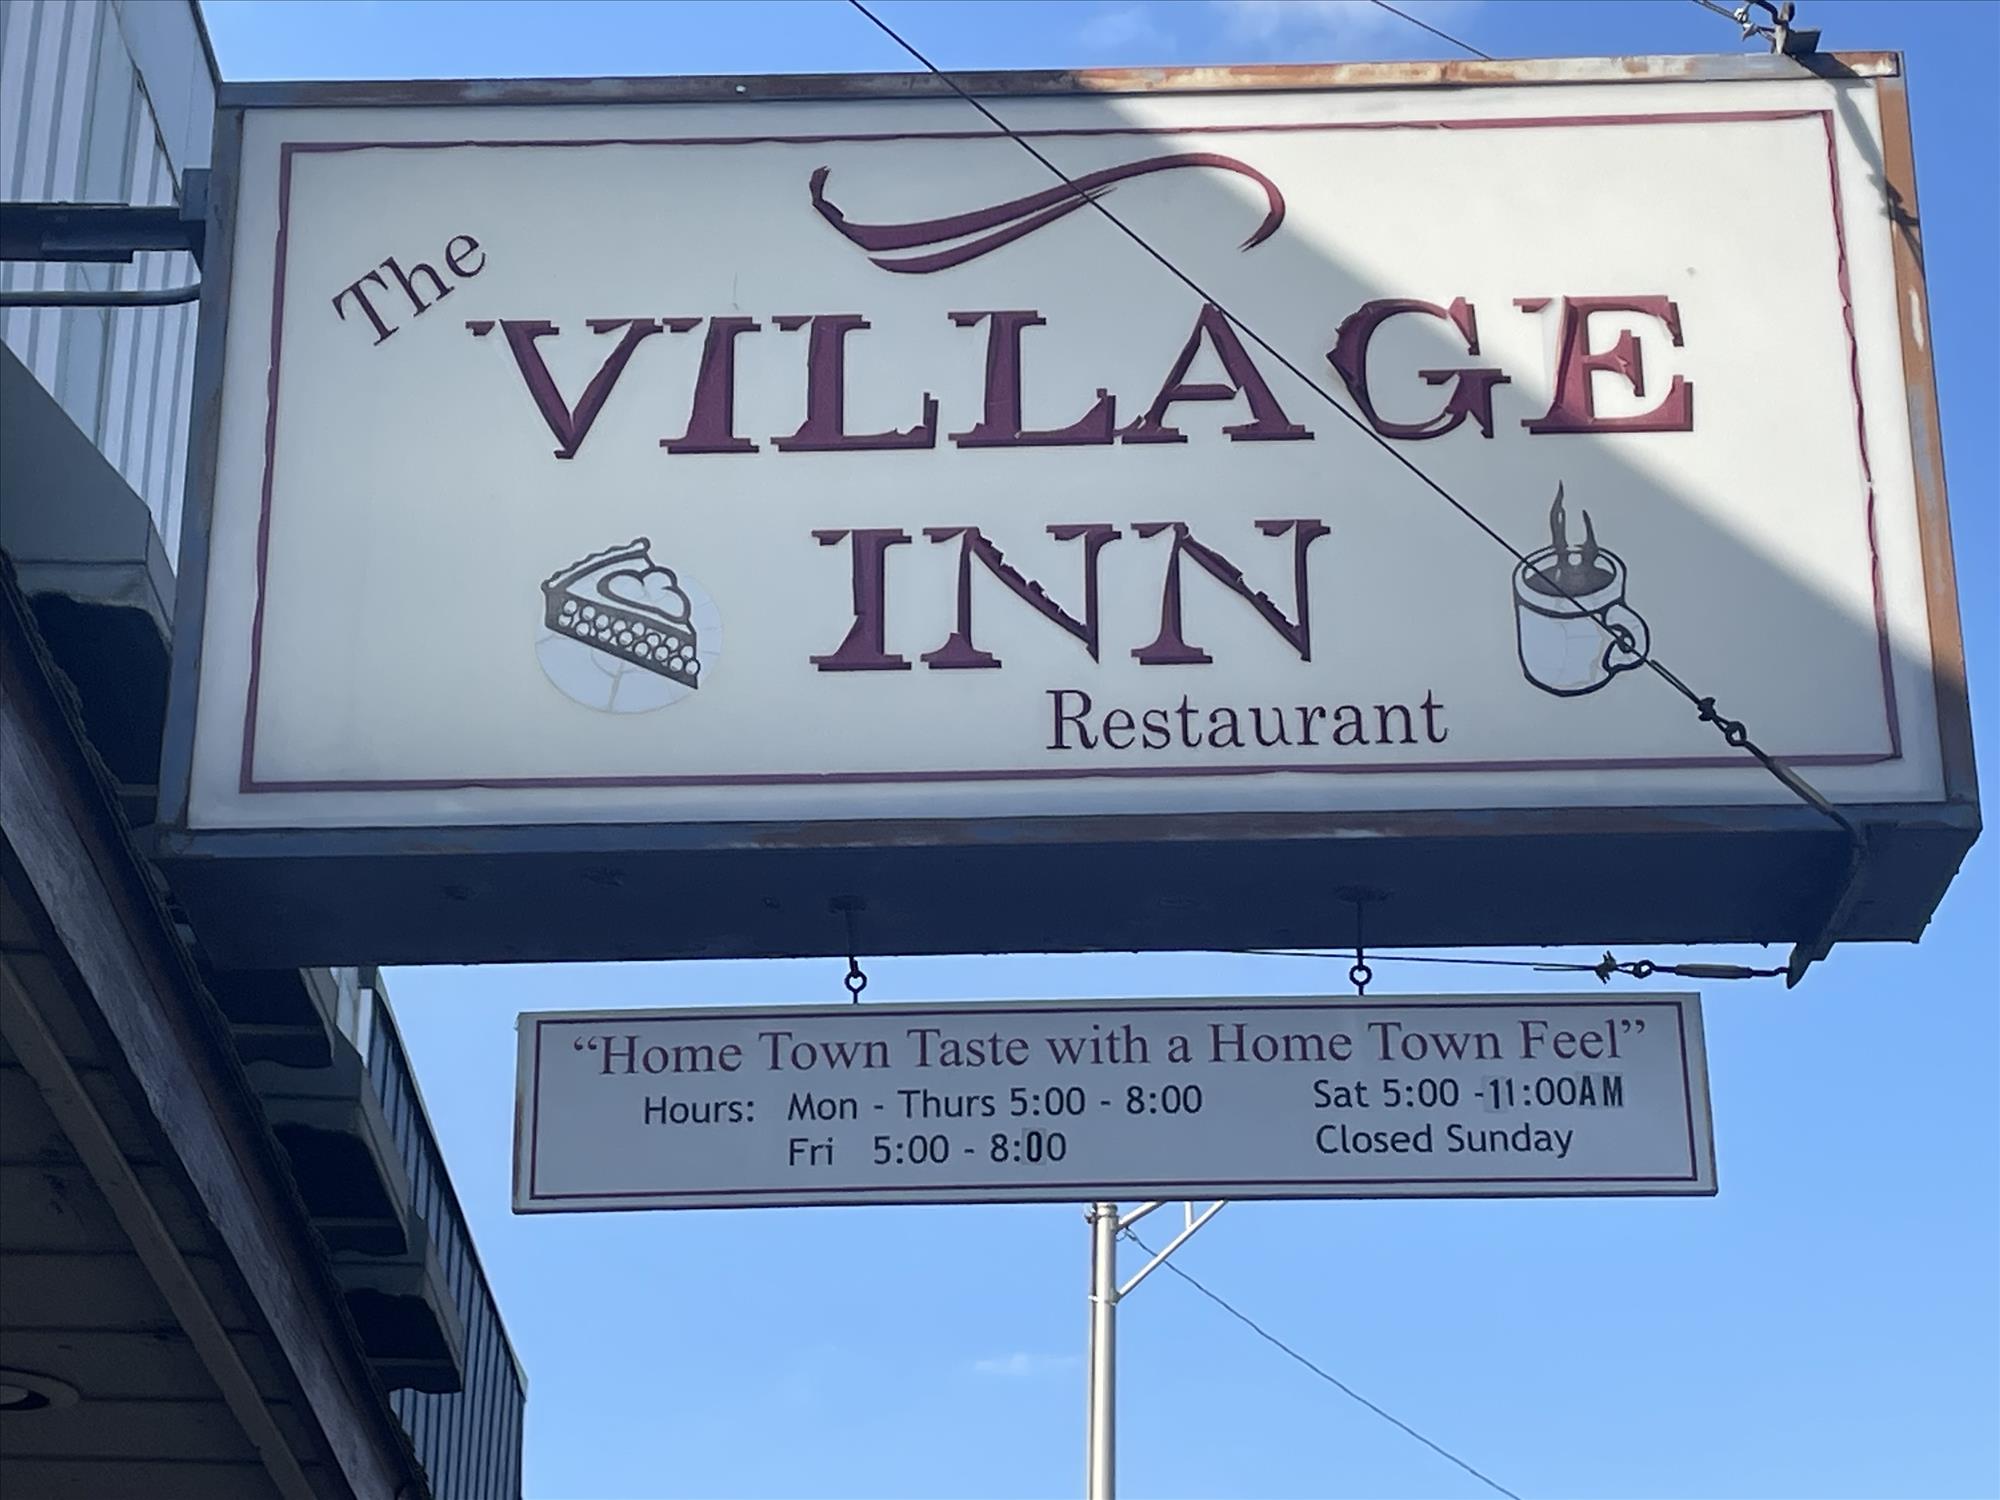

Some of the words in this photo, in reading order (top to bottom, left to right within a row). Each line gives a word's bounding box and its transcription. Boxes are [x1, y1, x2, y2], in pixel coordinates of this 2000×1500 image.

[331, 234, 487, 347] The
[465, 295, 1694, 460] VILLAGE
[809, 518, 1332, 673] INN
[1045, 689, 1448, 750] Restaurant
[758, 1031, 891, 1071] Town
[906, 1028, 1029, 1068] Taste
[1045, 1023, 1150, 1065] with
[1167, 1035, 1193, 1064] a
[1207, 1023, 1352, 1063] Home
[1367, 1021, 1503, 1061] Town
[644, 1095, 754, 1125] Hours:
[787, 1092, 858, 1121] Mon
[897, 1088, 996, 1119] Thurs
[1010, 1086, 1086, 1117] 5:00
[1126, 1084, 1203, 1115] 8:00
[1313, 1079, 1370, 1109] Sat
[1383, 1078, 1459, 1108] 5:00
[789, 1136, 833, 1167] Fri
[874, 1134, 949, 1165] 5:00
[990, 1130, 1067, 1163] 8:00
[1316, 1123, 1433, 1154] Closed
[1446, 1122, 1574, 1159] Sunday
